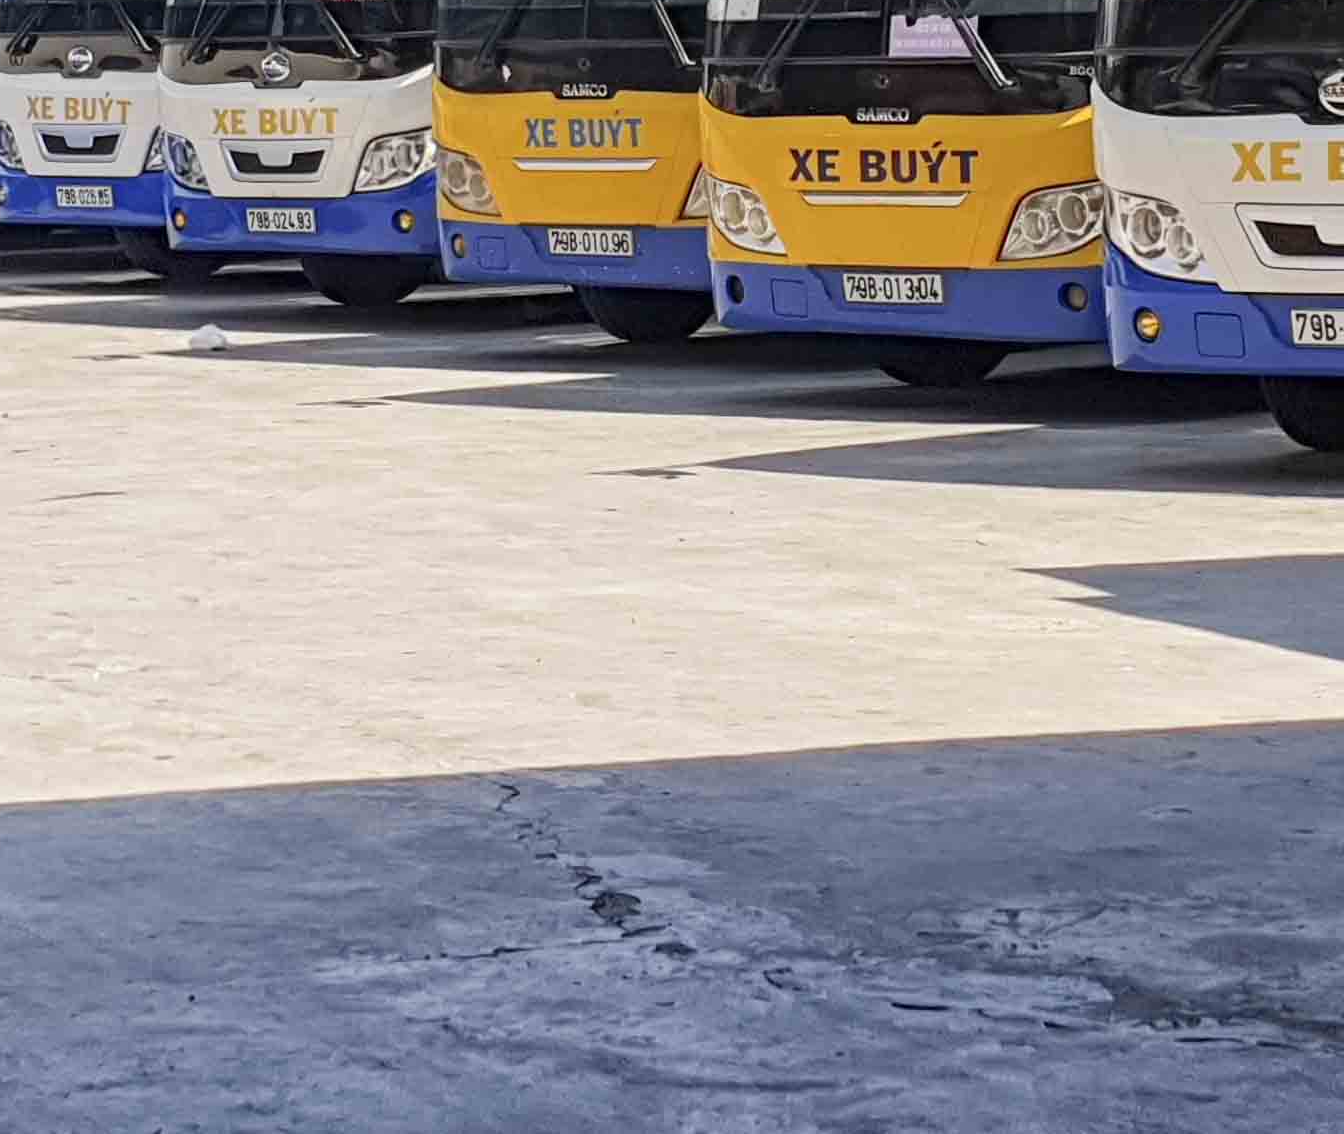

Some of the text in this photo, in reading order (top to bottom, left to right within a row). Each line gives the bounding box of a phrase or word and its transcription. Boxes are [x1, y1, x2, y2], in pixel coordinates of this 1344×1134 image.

[562, 83, 607, 97] SAMCO
[26, 92, 131, 124] XE BUÝT
[213, 109, 247, 135] XE
[856, 107, 910, 122] SAMCO
[525, 109, 642, 147] XE BUÝT
[789, 141, 979, 184] XE BUÝT
[1231, 141, 1302, 183] XE
